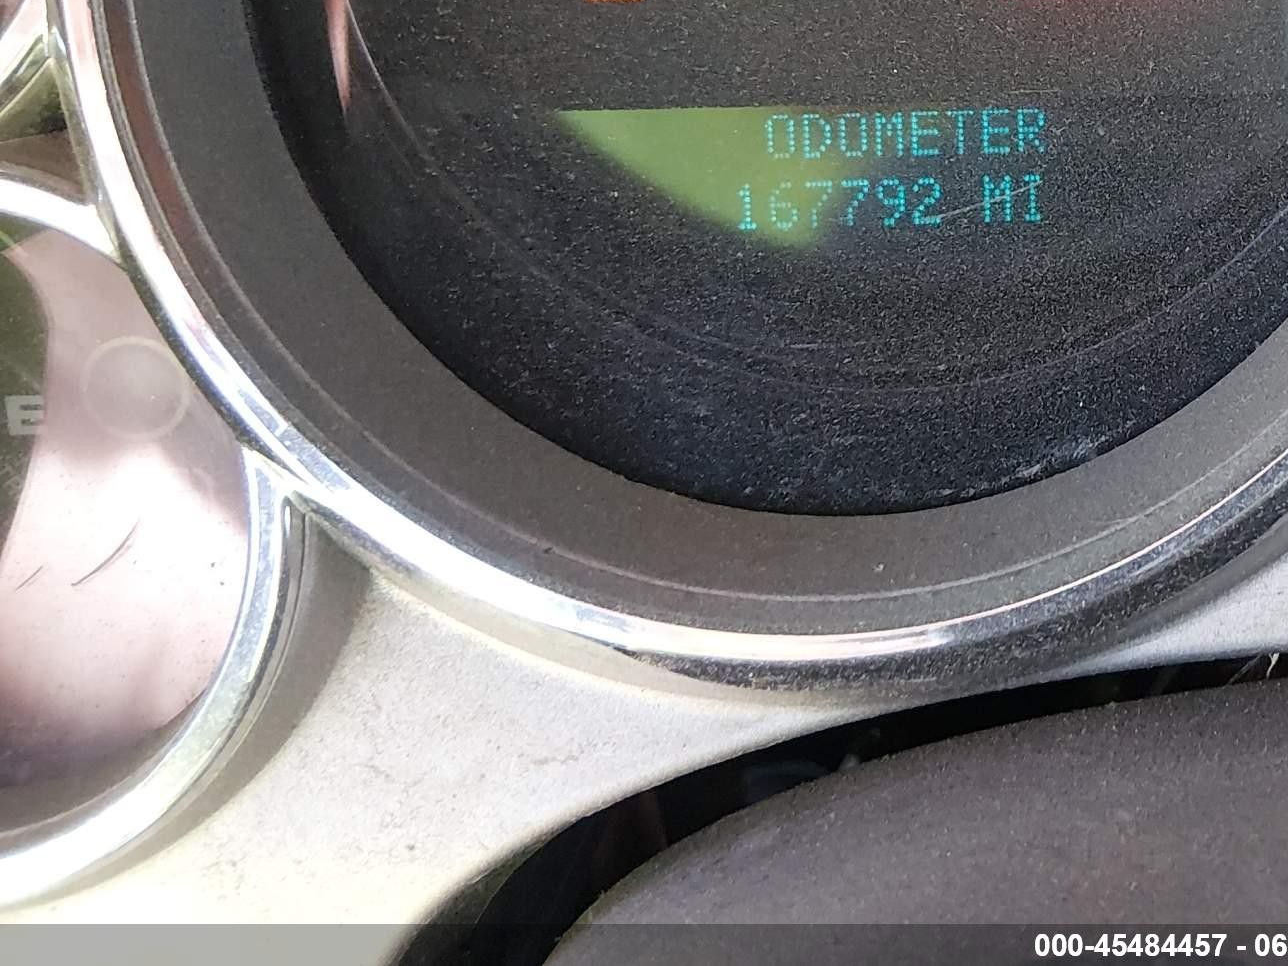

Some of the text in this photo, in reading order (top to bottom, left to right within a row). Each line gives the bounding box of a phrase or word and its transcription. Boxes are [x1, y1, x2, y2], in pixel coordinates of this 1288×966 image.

[765, 106, 1047, 159] ODOMETER
[735, 173, 1044, 231] 167792 MI
[5, 395, 47, 435] E
